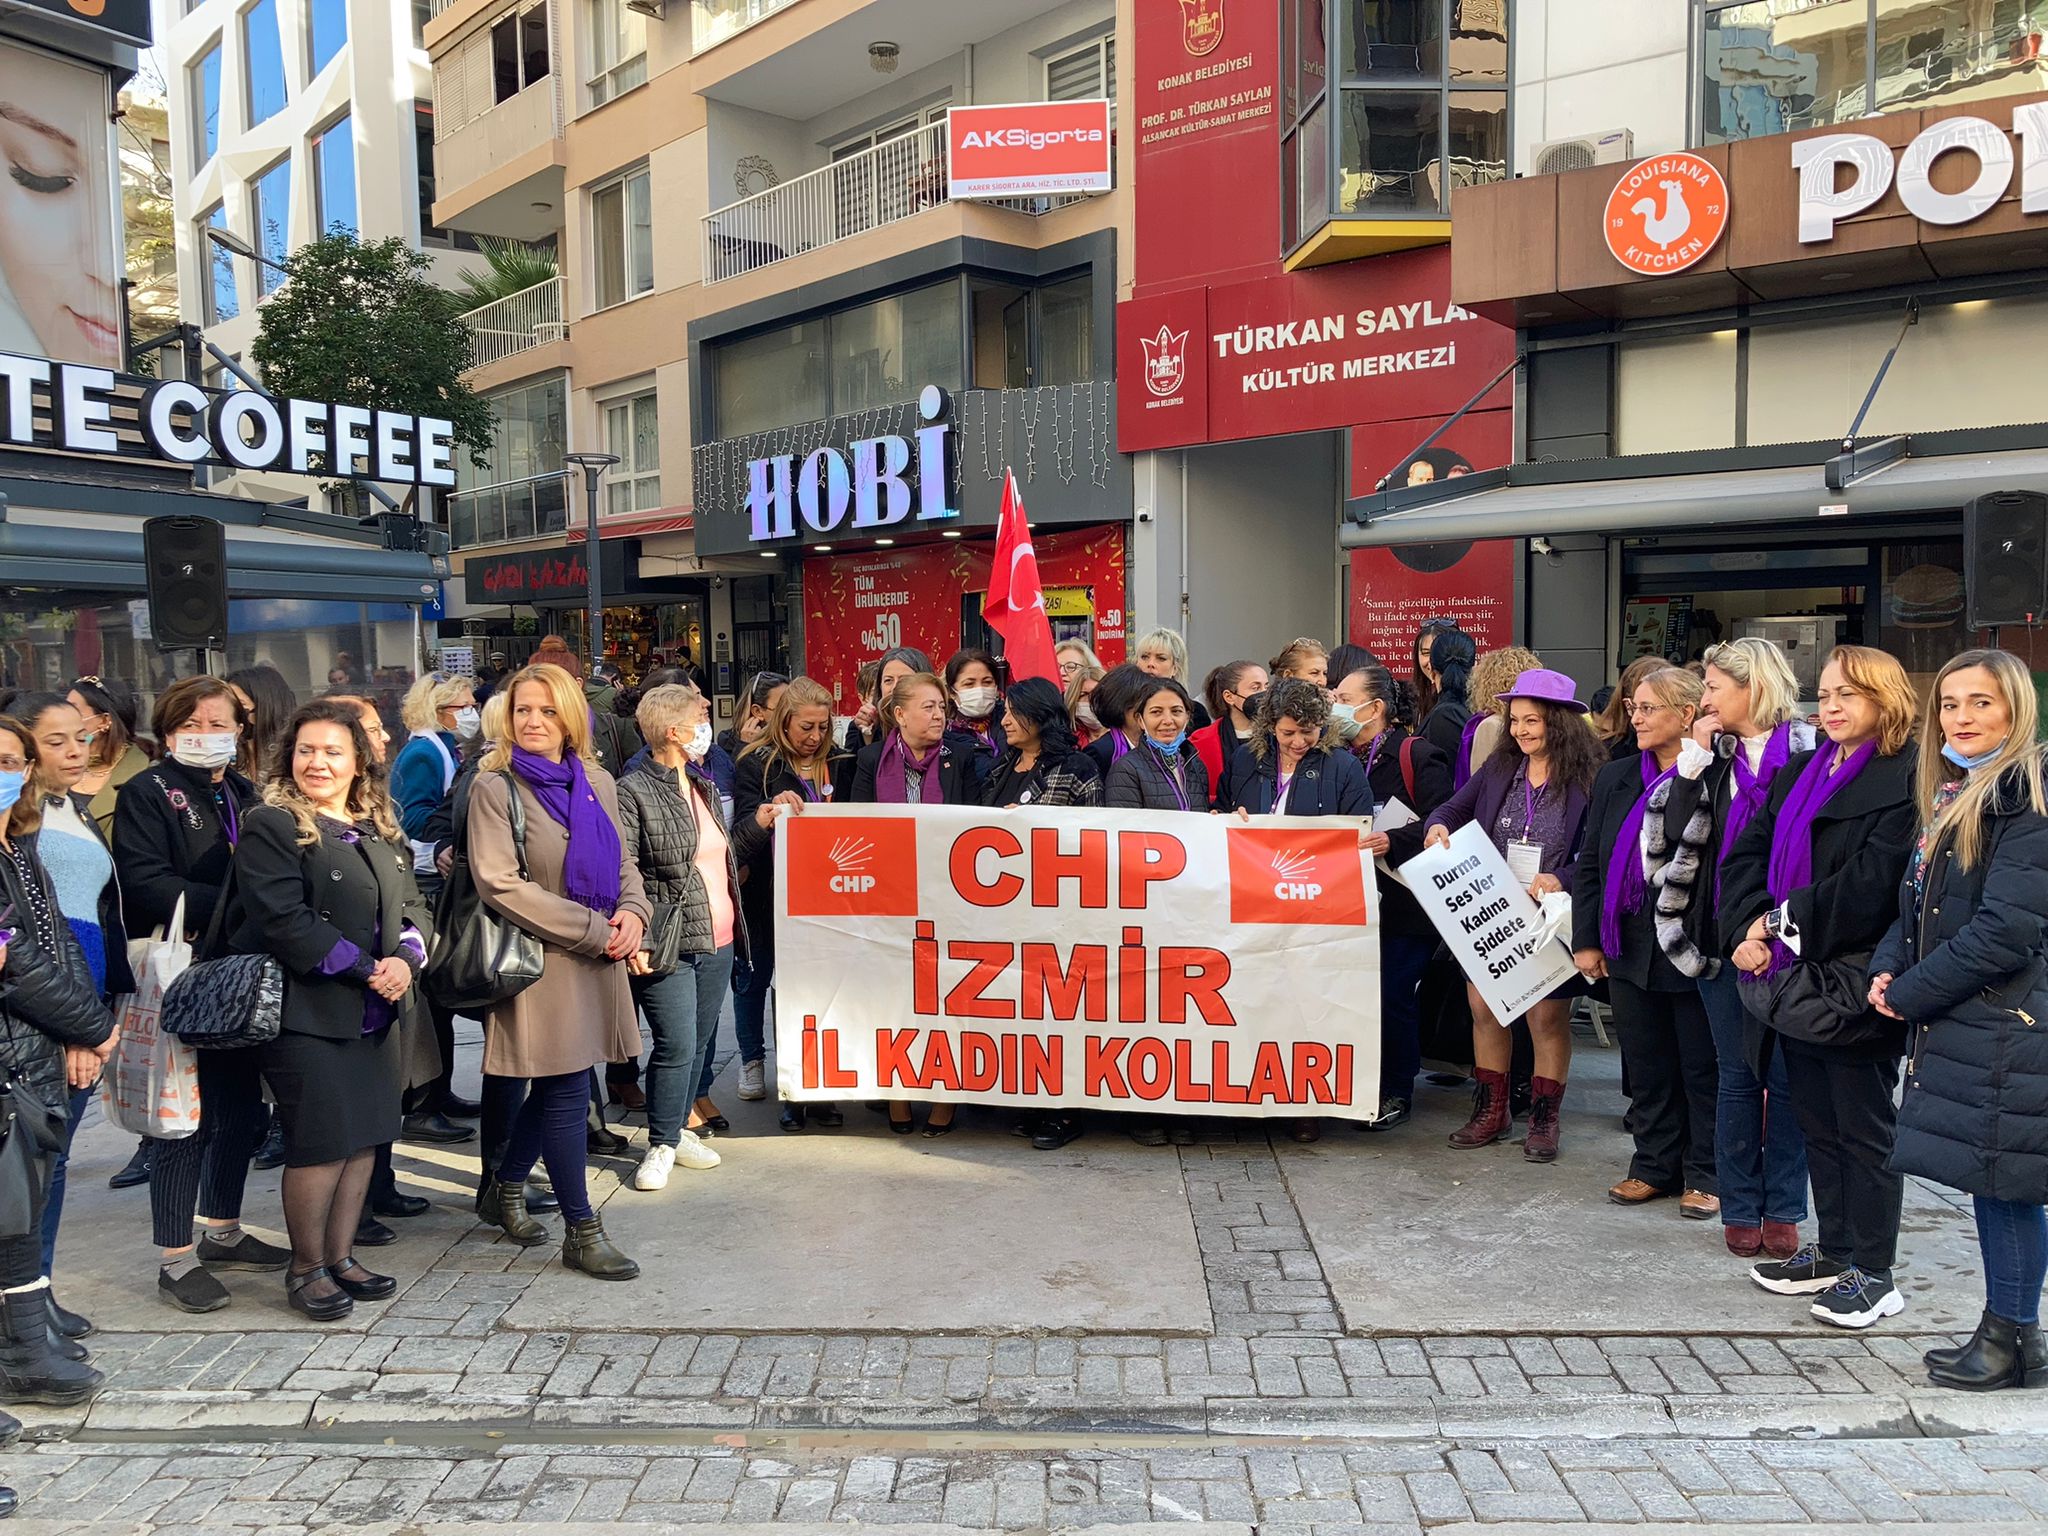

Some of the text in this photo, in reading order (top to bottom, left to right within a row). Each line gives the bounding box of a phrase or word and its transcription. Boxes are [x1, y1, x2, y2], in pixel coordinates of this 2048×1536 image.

[1158, 53, 1252, 91] KONAK BELEDİYESİ
[1142, 114, 1167, 128] PROF.
[1170, 108, 1186, 120] DR.
[1189, 97, 1228, 116] TÜRKAN
[1230, 86, 1271, 106] SAYLAN
[1142, 102, 1272, 144] ALSANCAK KÜLTÜR-SANAT MERKEZİ
[961, 128, 1103, 150] AKSigorta
[968, 183, 991, 191] KARER
[991, 181, 1020, 190] SİGORTA
[1620, 160, 1711, 198] LOUISIANA
[1612, 205, 1720, 228] 19 72
[1624, 237, 1704, 267] KITCHEN
[1213, 299, 1478, 357] TÜRKAN SAYLA
[1242, 341, 1455, 393] KÜLTÜR MERKEZİ
[150, 380, 455, 485] COFFEE
[743, 384, 960, 541] HOBİ
[853, 575, 875, 591] TÜM
[854, 591, 910, 608] ÜRÜNLERDE
[1100, 609, 1121, 627] %50
[1366, 596, 1503, 610] Sanat, güzelliğin ifadesidir...
[1368, 612, 1381, 621] Bu
[1384, 611, 1408, 621] ifade
[1410, 612, 1426, 621] söz
[1443, 610, 1473, 619] olursa
[1476, 609, 1495, 621] şiir,
[861, 613, 901, 651] %50
[1370, 639, 1393, 650] nakş
[1395, 639, 1408, 647] ile
[1372, 625, 1404, 636] nağme
[1406, 625, 1418, 633] ile
[1389, 652, 1401, 660] ile
[829, 875, 876, 893] CHP
[949, 825, 1188, 910] CHP
[1431, 853, 1482, 891] Durma
[1274, 882, 1323, 901] CHP
[1445, 872, 1496, 913] Ses Ver
[1459, 895, 1511, 935] Kadına
[1473, 915, 1526, 961] Şiddete
[913, 920, 1238, 1026] İZMİR
[1488, 953, 1518, 980] Son
[802, 1014, 1354, 1107] İL KADIN KOLLARI
